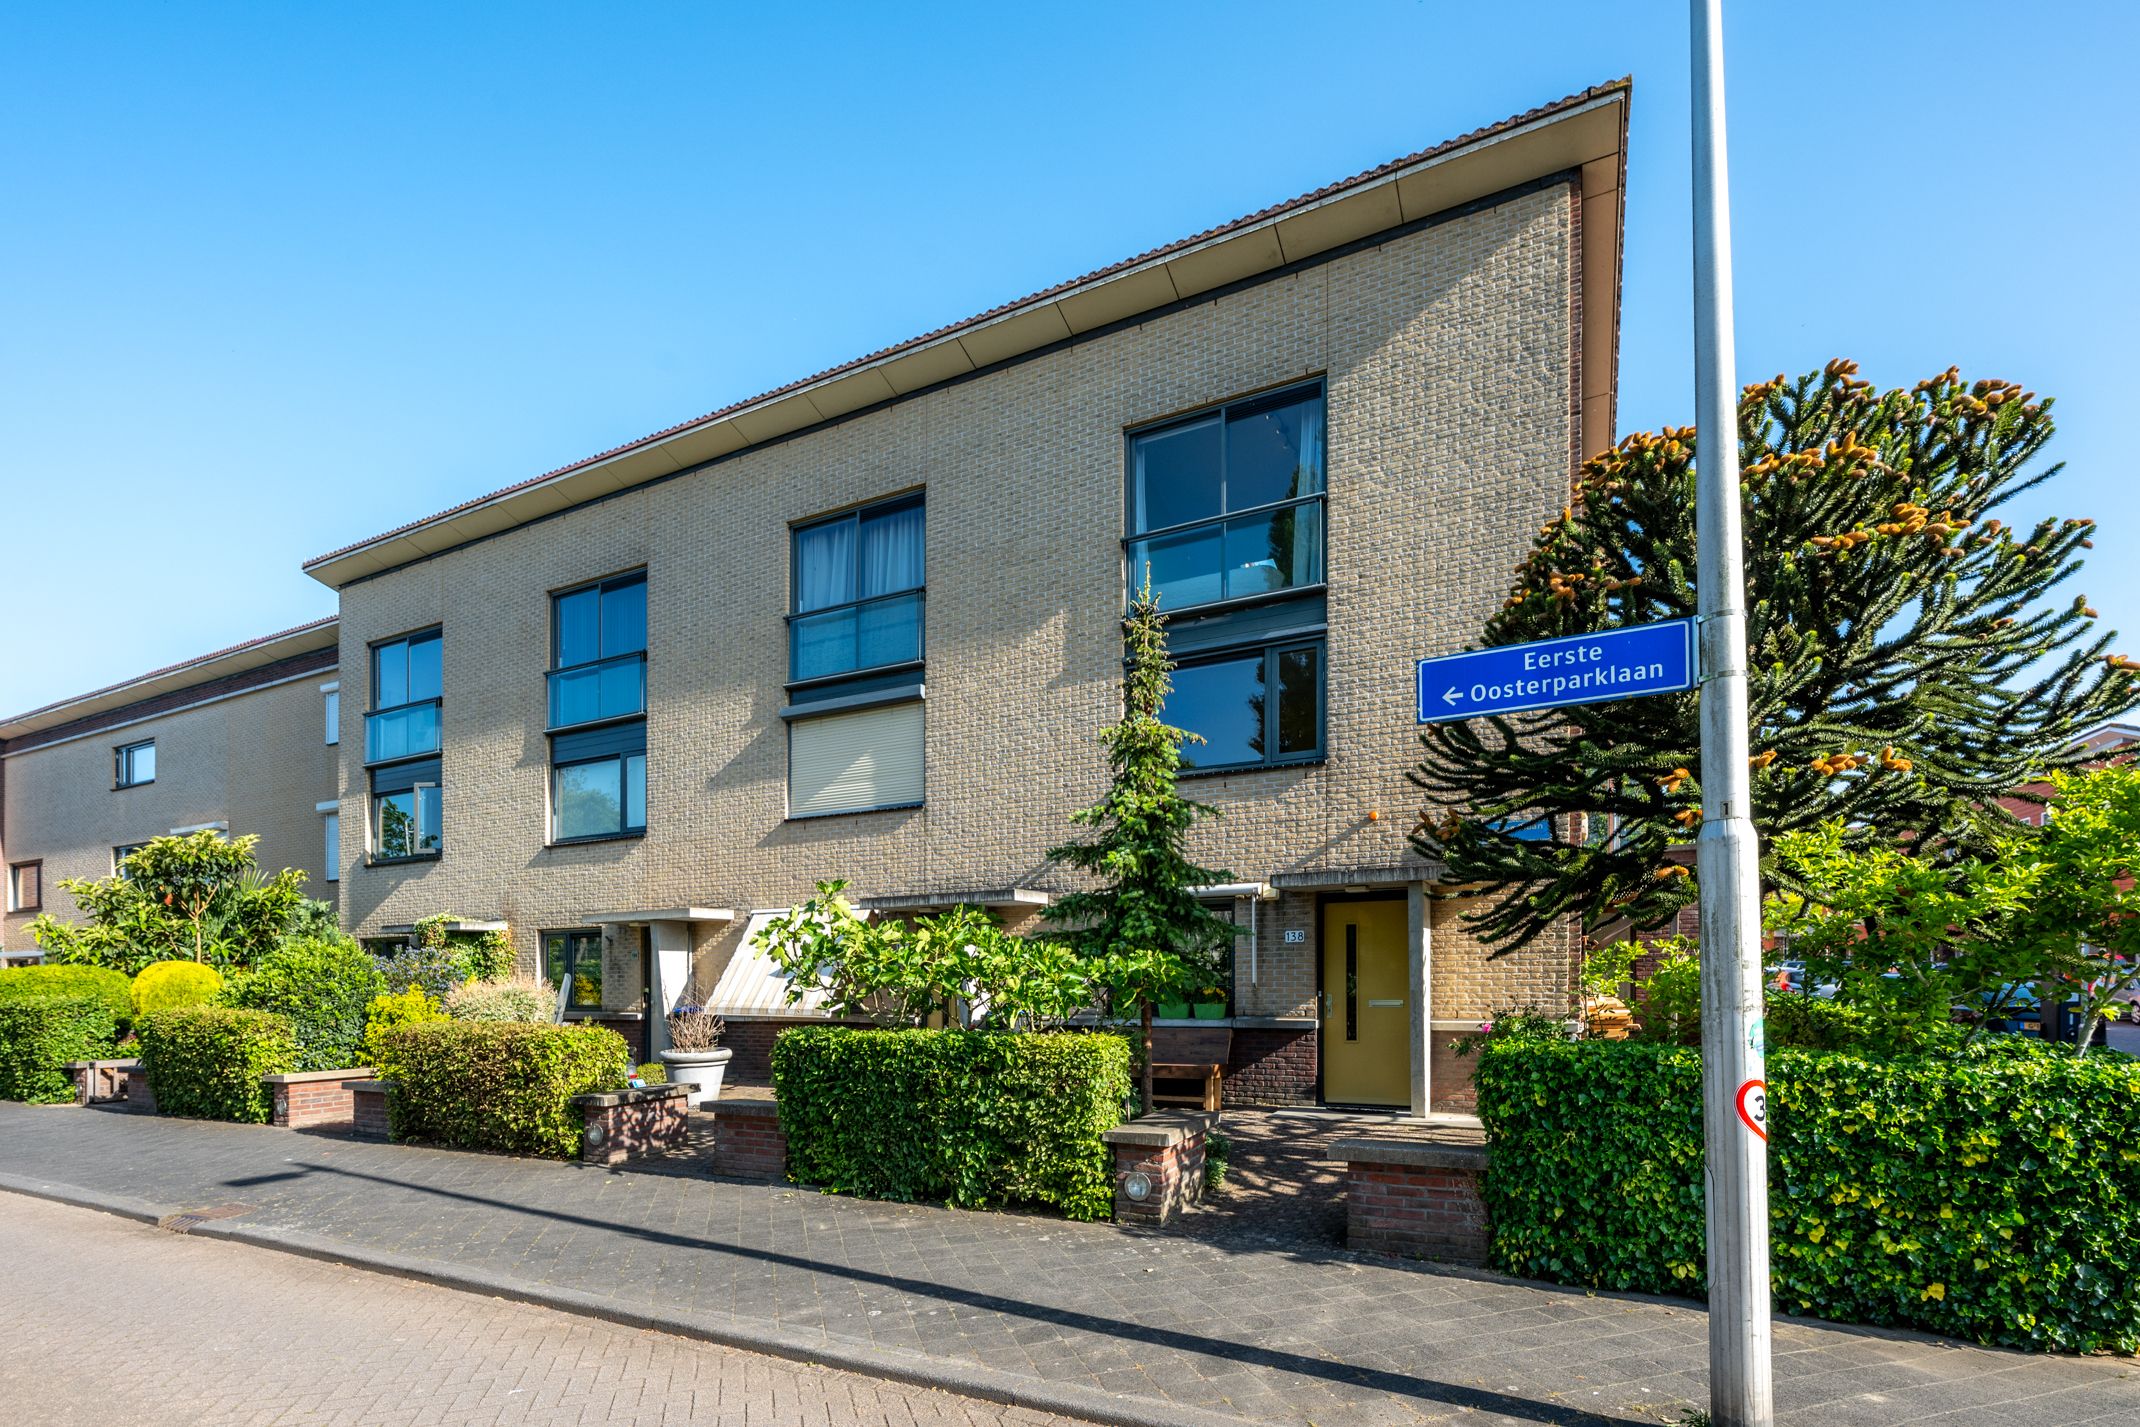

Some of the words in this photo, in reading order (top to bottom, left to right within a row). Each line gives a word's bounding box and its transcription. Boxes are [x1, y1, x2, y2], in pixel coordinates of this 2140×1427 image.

[1524, 646, 1603, 671] Eerste
[1470, 662, 1664, 702] Oosterparklaan
[1722, 802, 1729, 816] 1
[1286, 931, 1304, 942] 138
[1754, 1095, 1766, 1122] 3
